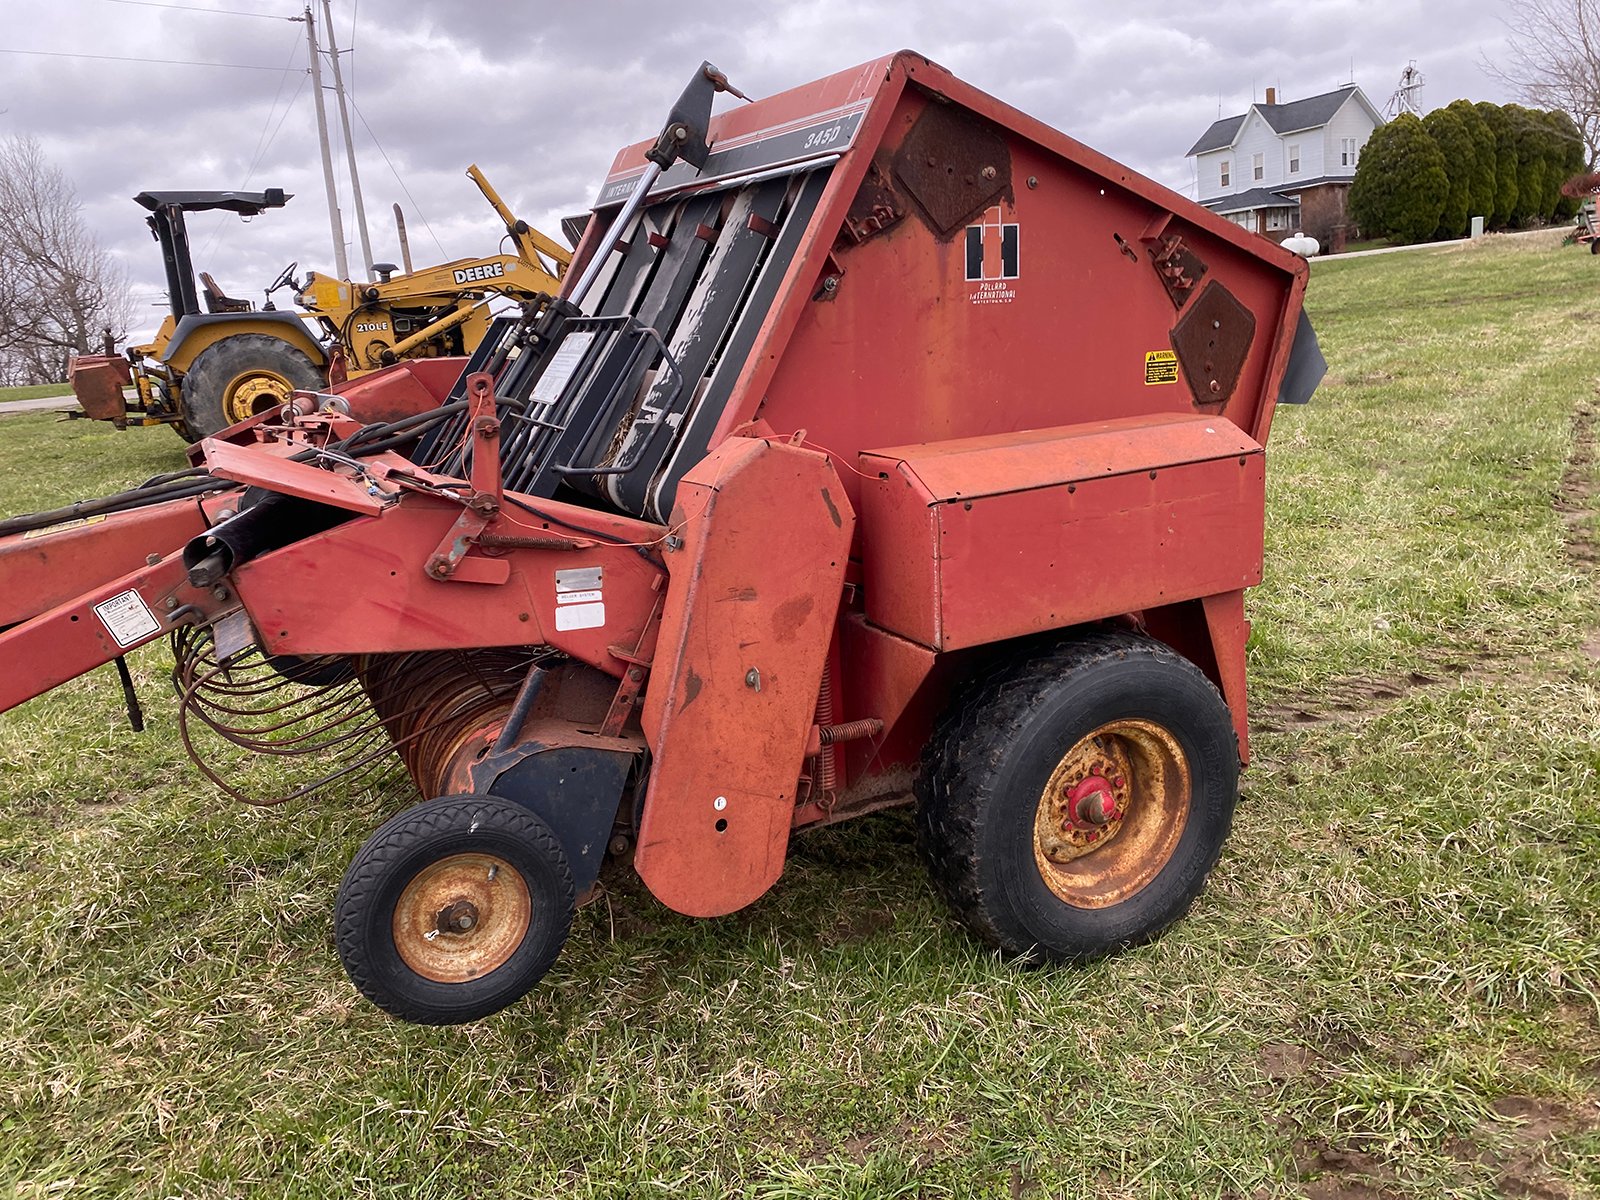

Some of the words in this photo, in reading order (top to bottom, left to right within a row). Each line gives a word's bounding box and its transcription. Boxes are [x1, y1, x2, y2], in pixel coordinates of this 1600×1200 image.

[804, 125, 841, 148] 345D
[454, 262, 504, 285] DEERE
[969, 290, 1016, 300] INTERNATIONAL
[357, 322, 388, 332] 210LE
[102, 594, 132, 611] IMPORTANT
